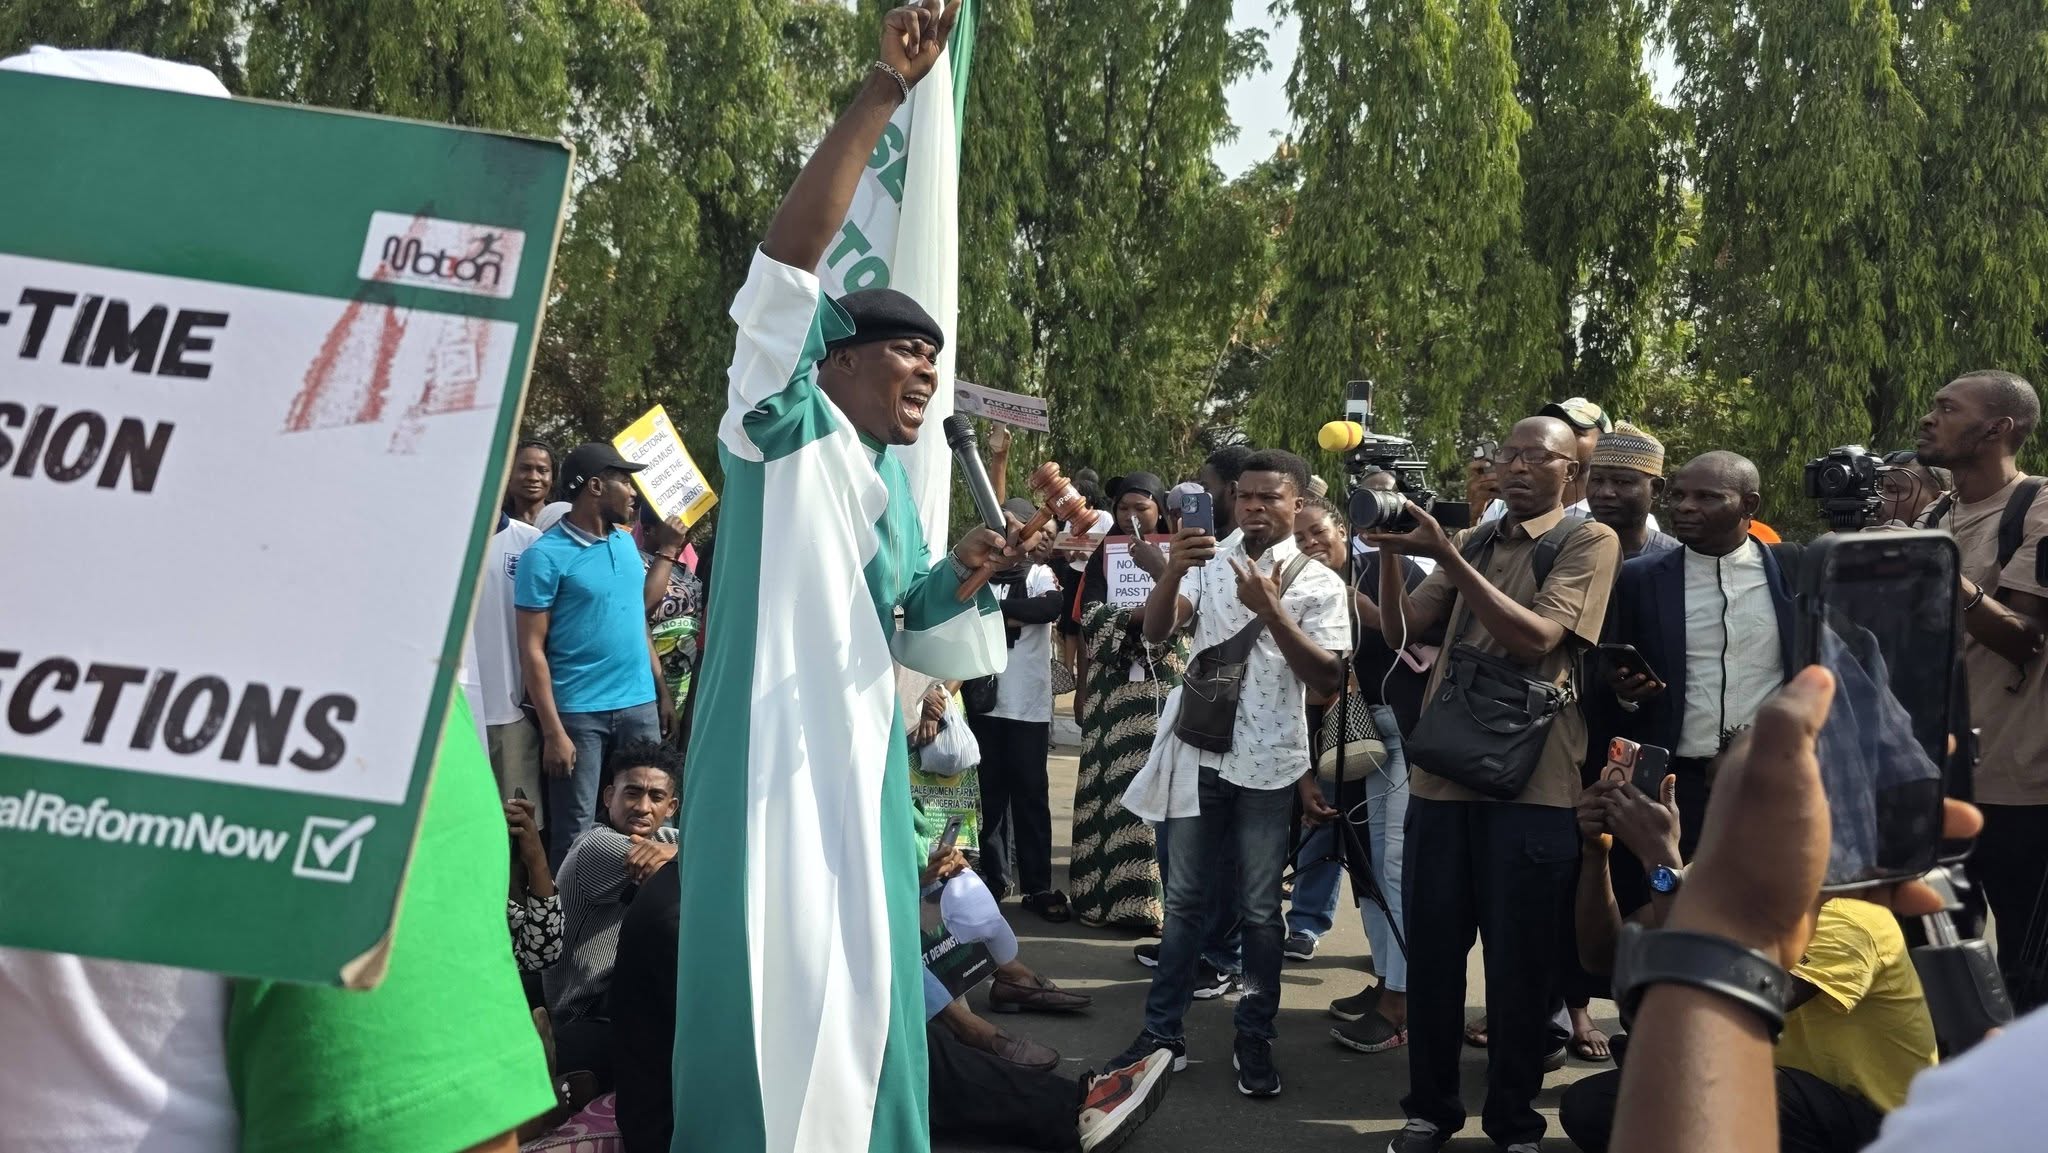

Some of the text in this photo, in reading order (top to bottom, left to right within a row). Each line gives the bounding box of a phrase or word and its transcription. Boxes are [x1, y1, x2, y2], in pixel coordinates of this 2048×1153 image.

[826, 219, 890, 294] TO
[985, 399, 1043, 416] AKPABIO
[631, 429, 669, 461] ELECTORAL
[658, 443, 677, 464] MUST
[650, 457, 685, 489] SERVE THE
[681, 467, 696, 488] NOT
[665, 483, 705, 517] INCUMBENTS
[1115, 587, 1140, 597] PASS
[928, 786, 954, 797] WOMEN
